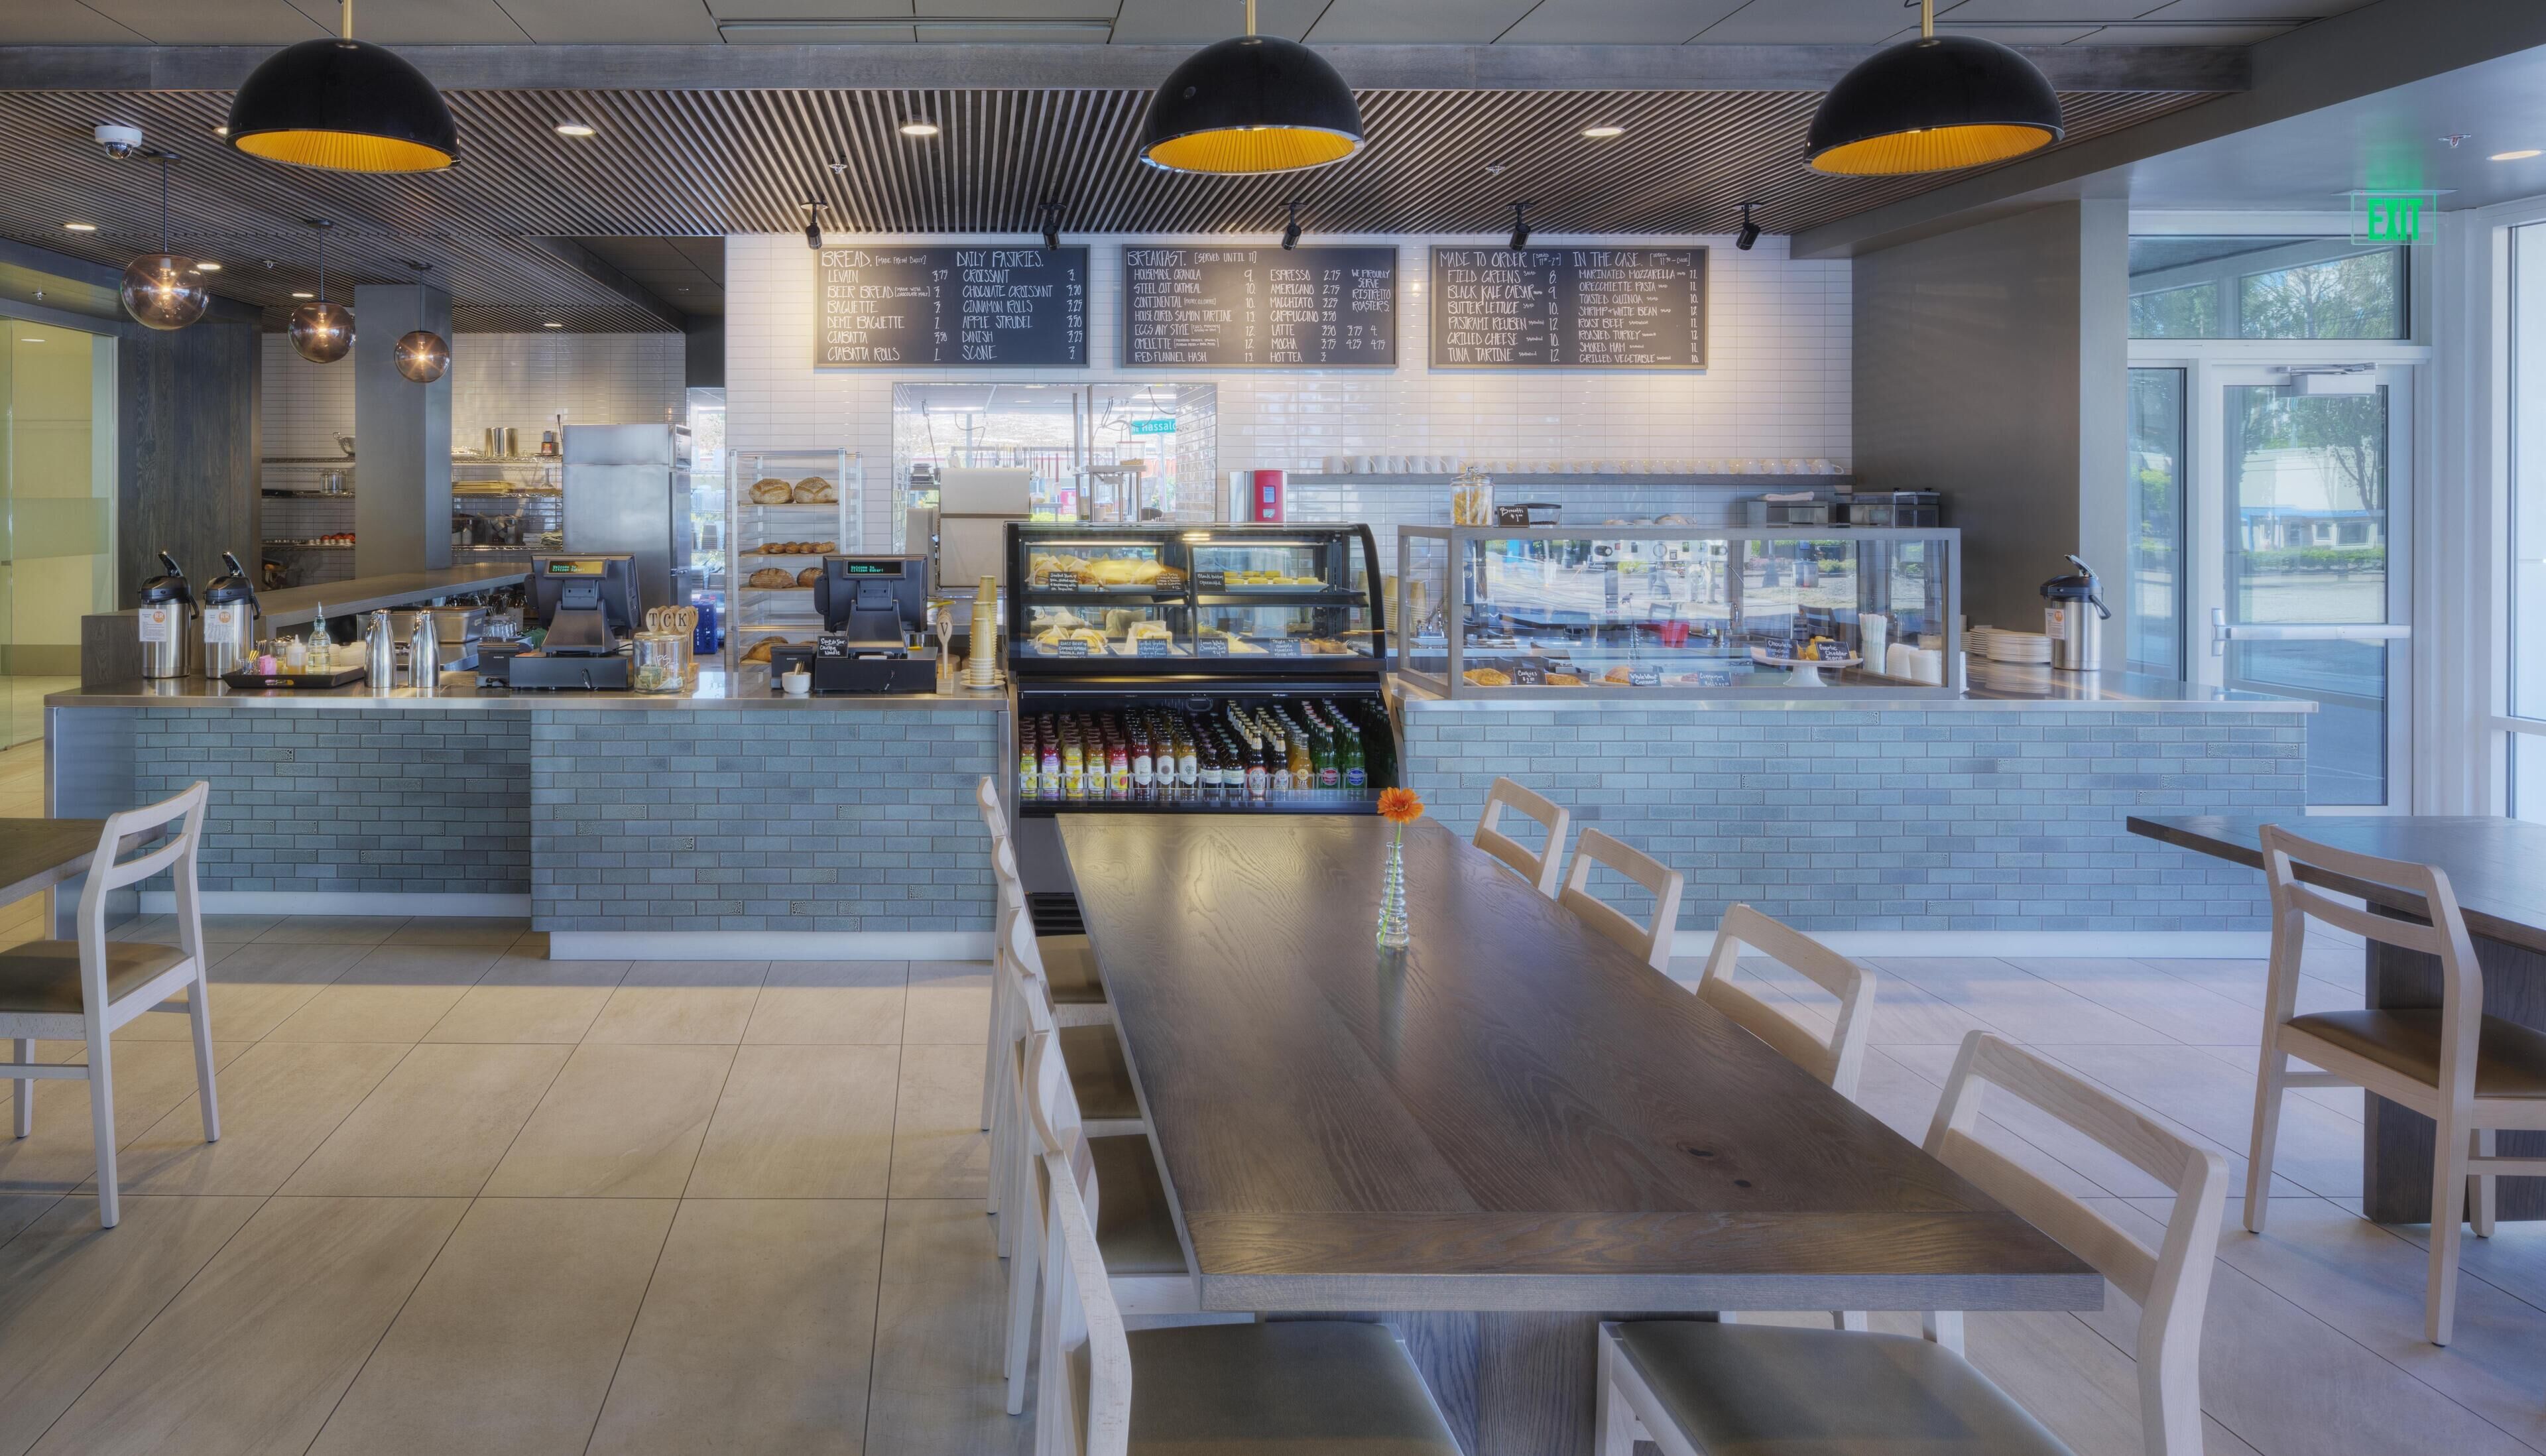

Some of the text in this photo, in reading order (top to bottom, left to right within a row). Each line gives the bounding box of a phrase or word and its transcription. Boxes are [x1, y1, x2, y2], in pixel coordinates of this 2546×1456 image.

[2367, 198, 2423, 241] EXIT
[821, 251, 872, 267] BREAD.
[957, 251, 1044, 268] DAILY PASTRIES.
[1127, 250, 1244, 267] BREAKFAST. UNTIL
[1440, 251, 1470, 267] MADE
[1473, 251, 1486, 267] TO
[1492, 251, 1528, 268] ORDER
[1573, 251, 1587, 267] IN
[1590, 251, 1612, 267] THE
[1614, 251, 1644, 267] CASE.
[828, 270, 948, 284] LEVAIN 3.75
[963, 269, 1010, 284] CROISSANT
[1134, 269, 1172, 280] HOUSEMADE
[1174, 269, 1202, 280] GRANOLA
[1270, 269, 1341, 281] ESPRESSO 2.75
[1362, 270, 1390, 278] PROUDLY
[1448, 269, 1477, 283] FIELD
[1481, 269, 1521, 284] GREENS
[1579, 269, 1675, 280] MARINATED MOZZARELLA
[1133, 282, 1156, 294] STEEL
[1158, 282, 1172, 294] CUT
[1174, 282, 1202, 294] OATMEAL
[1270, 284, 1341, 295] AMERICANO 2.75
[1358, 278, 1379, 289] SERVE
[1579, 281, 1656, 292] ORECCHIETTE PASTA
[827, 286, 894, 298] BEER BREAD
[962, 284, 1082, 298] CHOCOLATE CROISSANT 3.50
[1352, 288, 1391, 300] RISTRETTO
[1447, 284, 1535, 306] BLACK KALE CAESAR
[1134, 296, 1183, 308] CONTINENTAL
[1270, 297, 1338, 308] MACCHIATO 3.25
[1579, 294, 1609, 305] TOASTED
[1612, 294, 1644, 304] QUINOA
[827, 300, 879, 314] BAGUETTE
[963, 300, 1083, 314] CINNAMON ROLLS 3.25
[1352, 300, 1390, 313] ROASTERS.
[1447, 301, 1483, 314] BUTTER
[1485, 301, 1520, 314] LETTUCE
[1578, 306, 1658, 317] SHRIMP WHITE BEAN
[962, 315, 1082, 329] APPLE STRUDEL 3.50
[1135, 310, 1233, 322] HOUSE CURED SALMON TARTINE
[1270, 310, 1337, 322] CAPPUCCINO 3.50
[827, 316, 905, 329] DEMI BAGUETTE
[1448, 316, 1488, 330] PASTRAMI
[1492, 317, 1527, 331] REUBEN
[1578, 318, 1624, 328] ROAST BEEF
[1134, 324, 1154, 335] EGGS
[1155, 324, 1168, 335] ANY
[1170, 324, 1189, 335] STYLE
[1272, 324, 1363, 336] LATTE 3.50 3.75
[1579, 330, 1641, 340] ROASTED TURKEY
[827, 332, 868, 344] CIABATTA
[962, 330, 1083, 343] DANISH 3.25
[1447, 332, 1483, 345] GRILLED
[1485, 332, 1518, 345] CHEESE
[1134, 338, 1172, 349] OMELETTE
[1271, 338, 1386, 350] MOCHA 3.75 4.25 4.75
[1579, 342, 1625, 353] SMOKED HAM
[827, 347, 900, 362] CIABATTA ROLLS
[962, 345, 998, 361] SCONE
[1135, 351, 1207, 362] RED FLANNEL HASH
[1270, 352, 1303, 363] HOT TEA
[1447, 347, 1471, 363] TUNA
[1475, 347, 1514, 362] TARTINE
[1579, 354, 1612, 363] GRILLED
[1614, 354, 1656, 363] VEGETABLE
[650, 613, 657, 627] T
[664, 613, 671, 627] C
[678, 613, 686, 627] K
[940, 622, 948, 637] V
